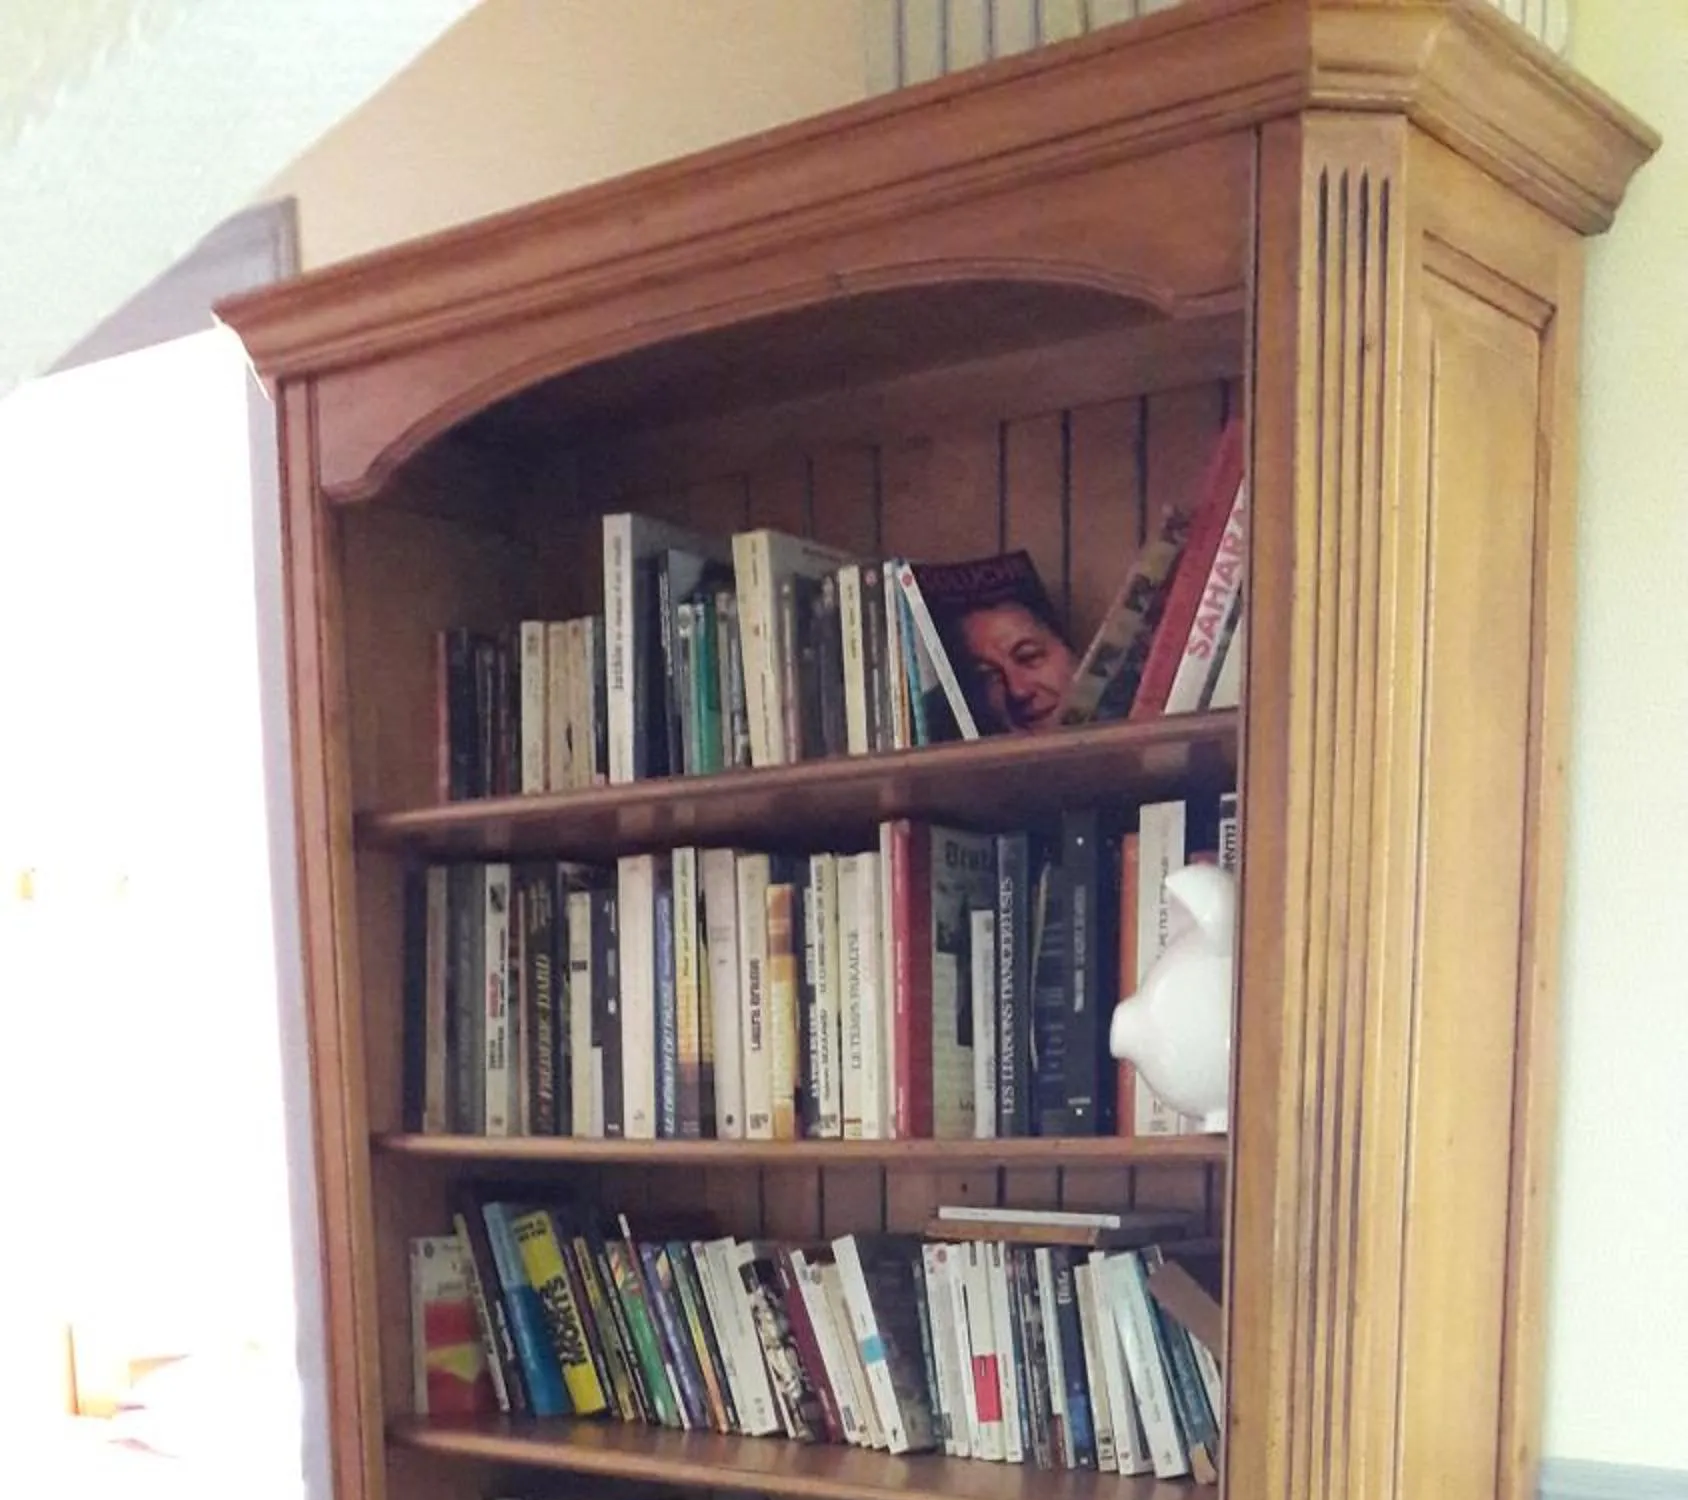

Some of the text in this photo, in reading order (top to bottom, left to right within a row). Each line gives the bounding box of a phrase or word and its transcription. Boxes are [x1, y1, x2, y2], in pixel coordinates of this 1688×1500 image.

[998, 876, 1015, 1115] LES LIAISONS DANGEREUSES
[849, 1001, 861, 1048] TEMPS
[850, 1050, 862, 1070] LE
